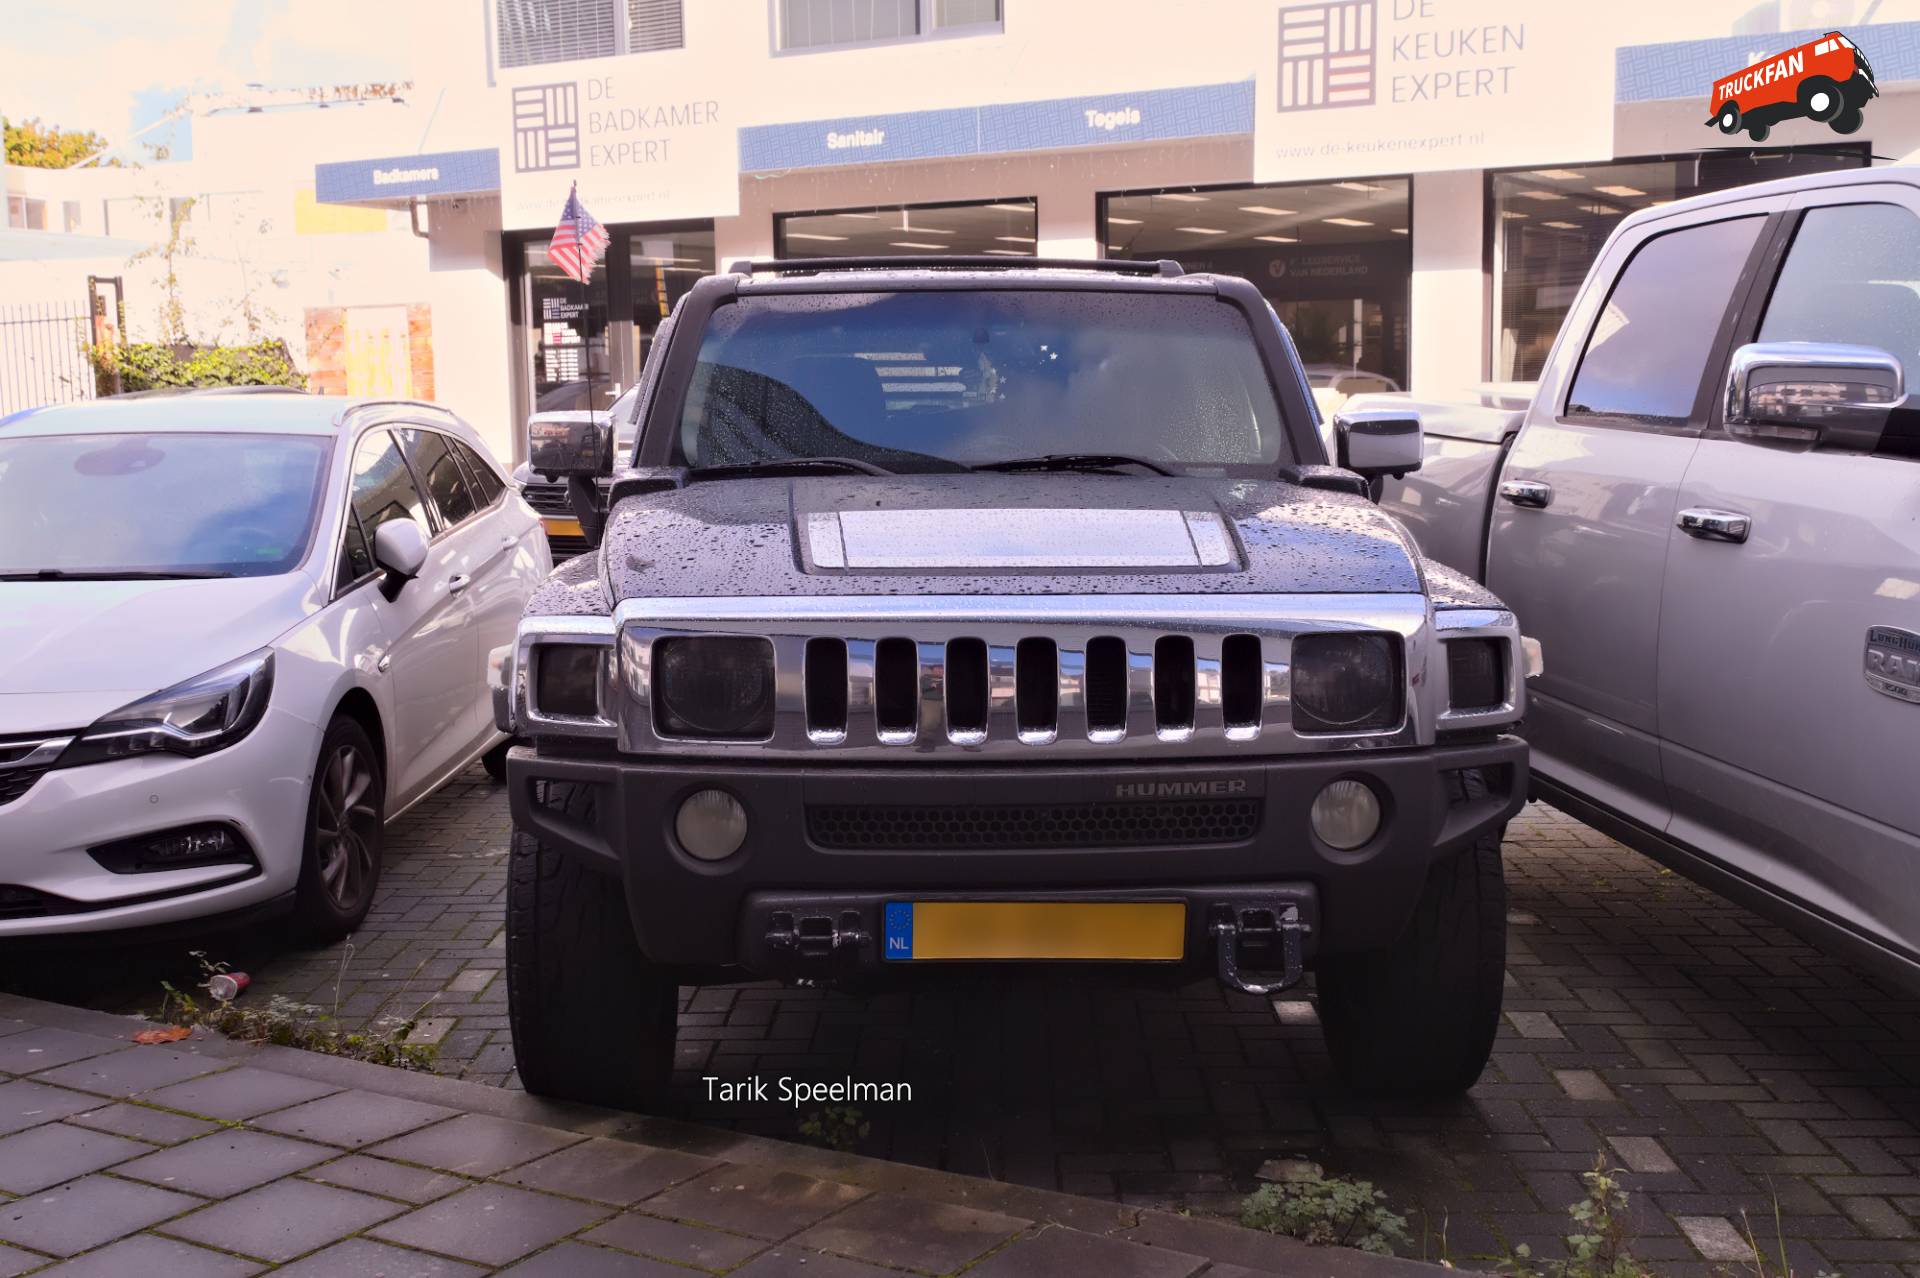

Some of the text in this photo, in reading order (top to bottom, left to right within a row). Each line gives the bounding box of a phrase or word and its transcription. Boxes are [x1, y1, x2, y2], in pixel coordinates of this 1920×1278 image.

[1392, 0, 1436, 21] DE
[1392, 23, 1525, 62] KEUKEN
[587, 76, 616, 101] DE
[1391, 65, 1517, 103] EXPERT
[588, 100, 720, 134] BADKAMER
[826, 128, 885, 149] Sanitair
[589, 138, 672, 167] EXPERT
[1115, 779, 1247, 798] HUMMER
[889, 936, 910, 951] NL
